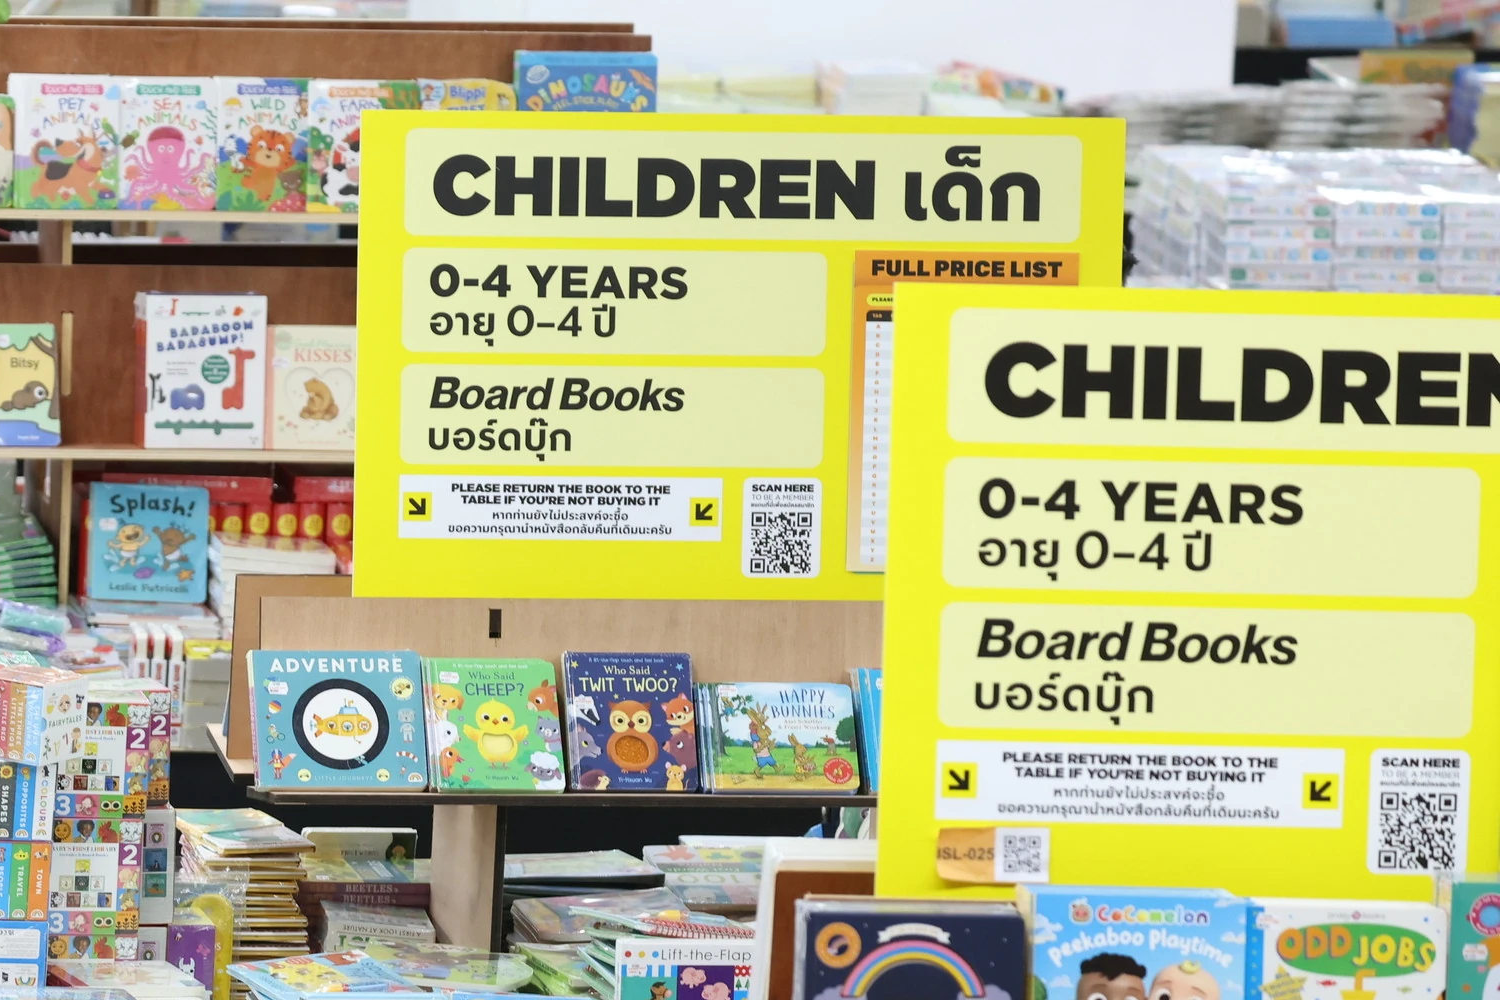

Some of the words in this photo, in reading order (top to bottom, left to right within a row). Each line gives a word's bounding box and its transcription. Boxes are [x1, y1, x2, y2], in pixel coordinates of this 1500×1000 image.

[450, 86, 485, 100] Blippi
[527, 72, 648, 112] DINOSAURS
[59, 98, 85, 110] PET
[153, 99, 181, 110] SEA
[251, 99, 285, 110] WILD
[43, 112, 100, 130] ANIMALS
[137, 113, 197, 130] ANIMALS
[239, 113, 297, 130] ANIMALS
[432, 153, 876, 221] CHILDREN
[904, 145, 1041, 222] เด็ก
[872, 260, 929, 276] FULL
[935, 261, 1004, 277] PRICE
[1011, 262, 1062, 277] LIST
[429, 264, 511, 299] 0-4
[528, 266, 688, 300] YEARS
[170, 321, 253, 338] BADABOOM
[429, 309, 494, 346] อายุ
[592, 304, 616, 337] ปี
[10, 357, 39, 370] Bitsy
[294, 348, 352, 362] KISSES
[431, 376, 552, 411] Board
[561, 379, 684, 412] Books
[428, 418, 572, 461] บอร์ดบุ๊ก
[452, 483, 500, 493] PLEASE
[503, 484, 555, 494] RETURN
[558, 485, 582, 494] THE
[586, 485, 621, 494] BOOK
[625, 485, 642, 494] TO
[646, 485, 670, 495] THE
[752, 484, 782, 492] SCAN
[784, 484, 814, 492] HERE
[110, 494, 195, 517] Splash!
[461, 495, 501, 505] TABLE
[504, 496, 516, 505] IF
[519, 496, 564, 505] YOU'RE
[568, 496, 595, 506] NOT
[598, 497, 645, 506] BUYING
[648, 497, 660, 506] IT
[979, 478, 1080, 519] 0-4
[1102, 482, 1304, 526] YEARS
[978, 537, 1060, 581] อายุ
[1184, 530, 1212, 572] ปี
[977, 618, 1133, 661] Board
[1140, 623, 1298, 665] Books
[270, 658, 403, 672] ADVENTURE
[604, 665, 627, 675] Who
[629, 666, 650, 675] Said
[469, 672, 491, 680] Who
[494, 672, 514, 680] Said
[579, 677, 614, 692] TWIT
[623, 678, 678, 692] TWOO?
[465, 682, 524, 696] CHEEP?
[779, 689, 825, 703] HAPPY
[975, 673, 1154, 725] บอร์ดบุ๊ก
[771, 705, 835, 719] BUNNIES
[49, 715, 82, 728] FAIRYTALES
[130, 729, 145, 748] 2
[1003, 752, 1063, 763] PLEASE
[1068, 753, 1131, 765] RETURN
[1137, 755, 1167, 766] THE
[1172, 755, 1216, 767] BOOK
[1222, 756, 1242, 767] TO
[1248, 757, 1278, 769] THE
[1382, 757, 1418, 768] SCAN
[1423, 758, 1460, 768] HERE
[1014, 767, 1064, 778] TABLE
[1069, 768, 1083, 778] IF
[1087, 768, 1144, 780] YOU'RE
[1149, 770, 1182, 781] NOT
[1187, 771, 1246, 782] BUYING
[1251, 772, 1265, 783] IT
[56, 796, 70, 815] 3
[346, 884, 393, 892] BEETLES
[1099, 907, 1209, 924] CoComelon
[661, 950, 751, 962] Lift-the-Flap
[1149, 929, 1233, 967] Playtime
[1277, 925, 1352, 960] ODD
[1352, 934, 1436, 973] JOBS
